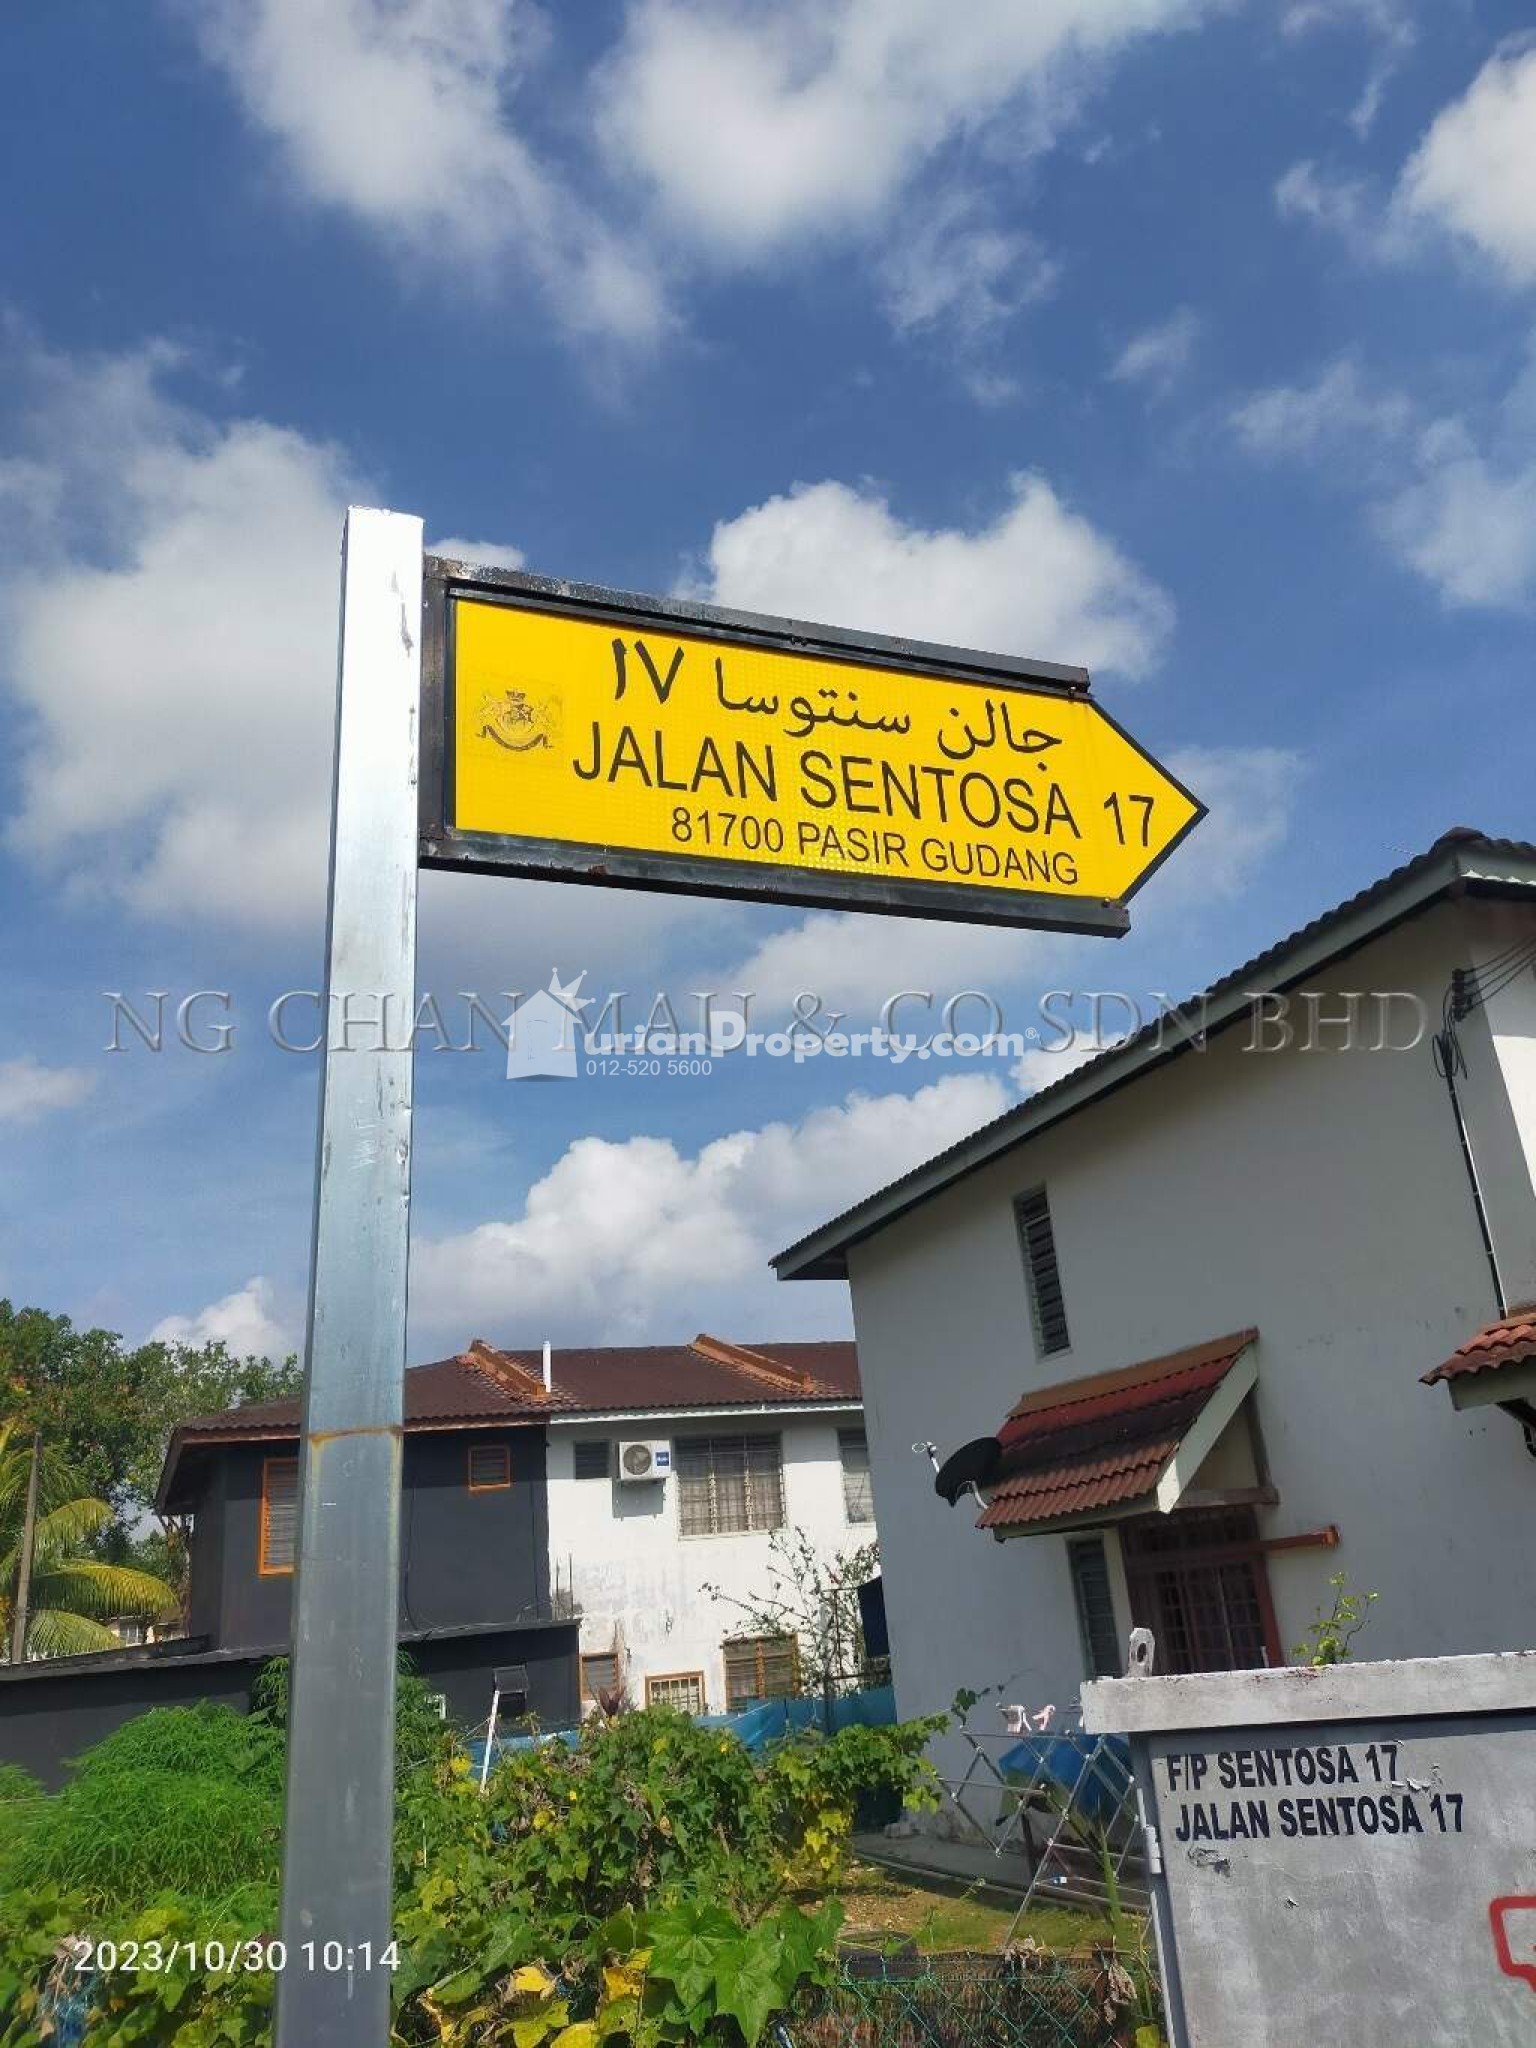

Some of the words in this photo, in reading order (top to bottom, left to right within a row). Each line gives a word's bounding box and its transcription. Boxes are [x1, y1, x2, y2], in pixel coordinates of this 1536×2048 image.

[937, 699, 1063, 772] جالن
[572, 721, 778, 801] JALAN
[800, 750, 1082, 839] SENTOSA
[1103, 791, 1155, 847] 17
[672, 806, 784, 852] 81700
[798, 821, 910, 867] PASIR
[920, 838, 1079, 886] GUDANG
[1217, 1746, 1359, 1789] SENTOSA
[1365, 1744, 1398, 1782] 17
[1175, 1800, 1271, 1842] JALAN
[1277, 1795, 1424, 1838] SENTOSA
[1429, 1793, 1464, 1833] 17
